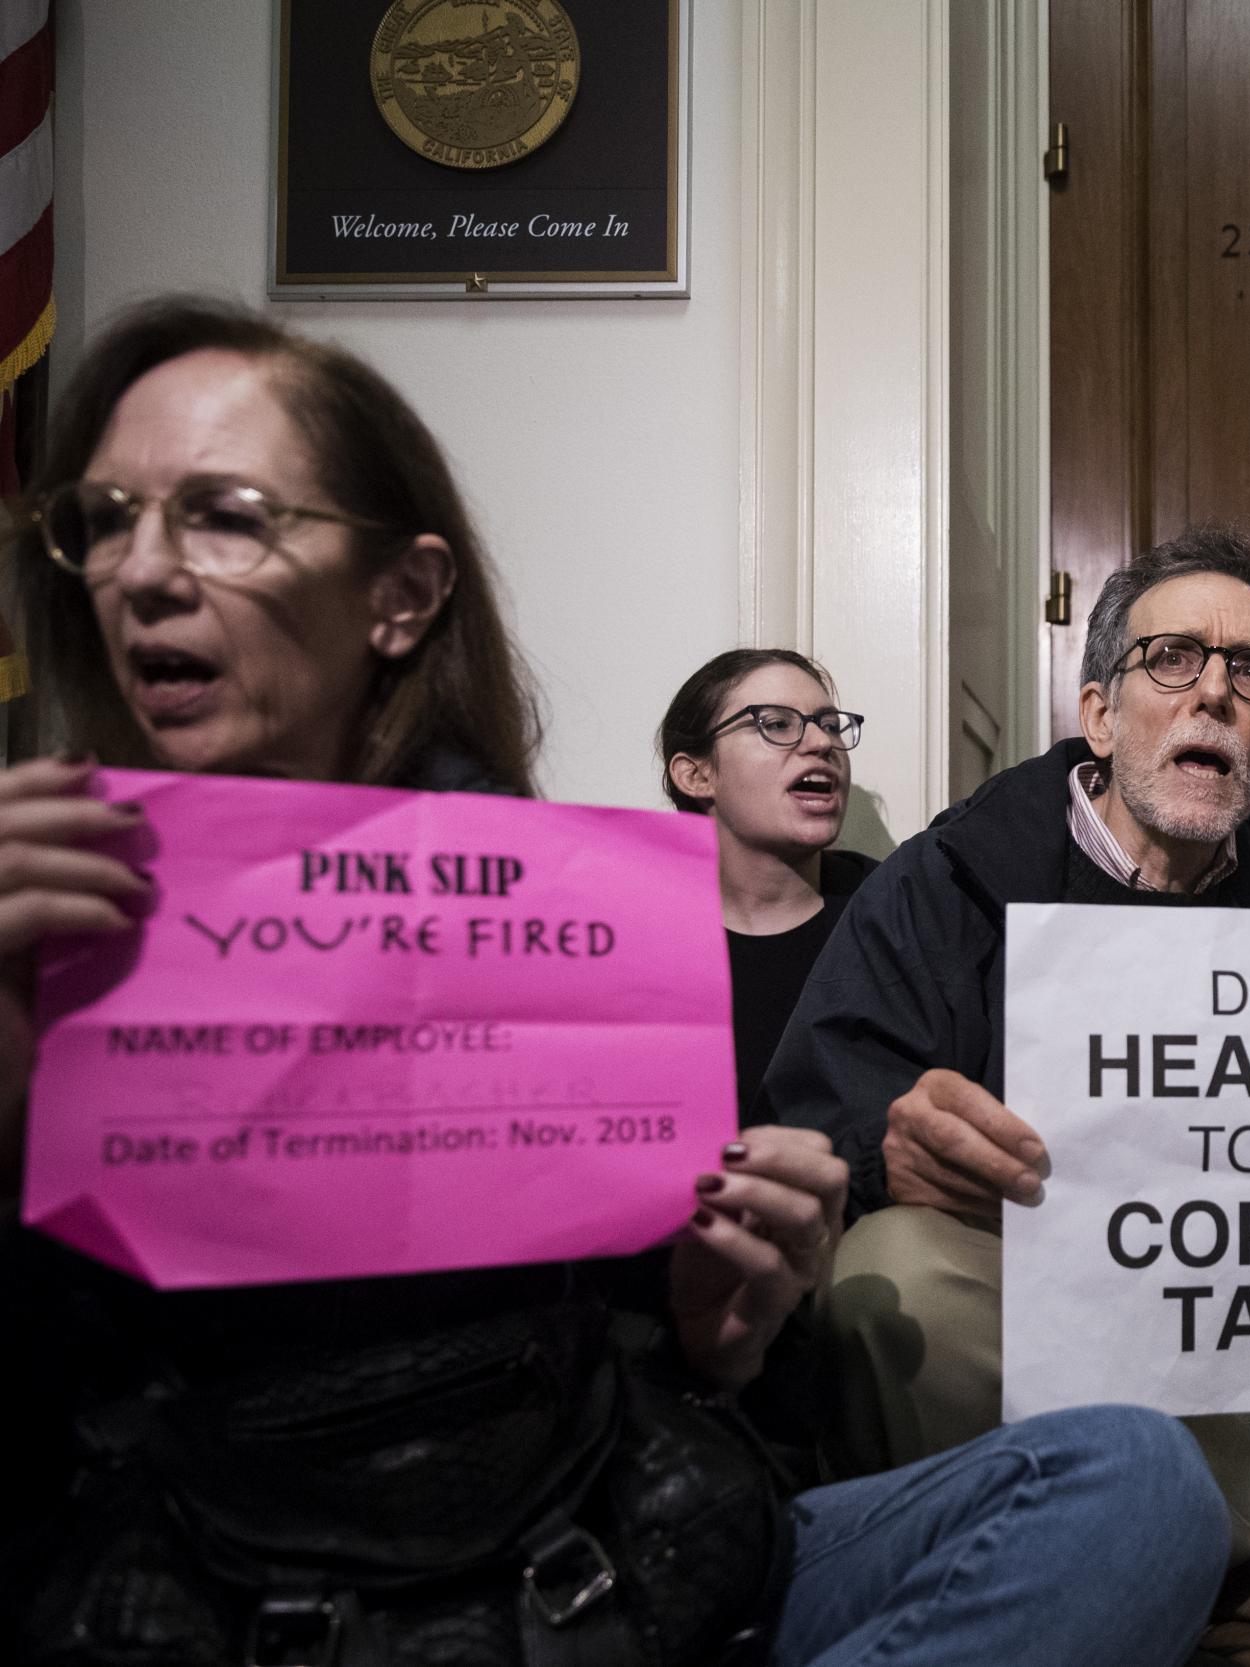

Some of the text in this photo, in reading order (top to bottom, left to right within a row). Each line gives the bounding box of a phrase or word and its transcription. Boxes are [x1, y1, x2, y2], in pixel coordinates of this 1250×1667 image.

[421, 138, 529, 165] CALIFORNIA
[331, 213, 630, 241] Welcome, Please Come In
[300, 850, 525, 898] PINK SLIP
[184, 914, 617, 960] YOU'RE FIRED
[106, 1020, 514, 1058] NAME OF EMPLOYEE:
[104, 1116, 677, 1168] Date of Termination: Nov. 2018
